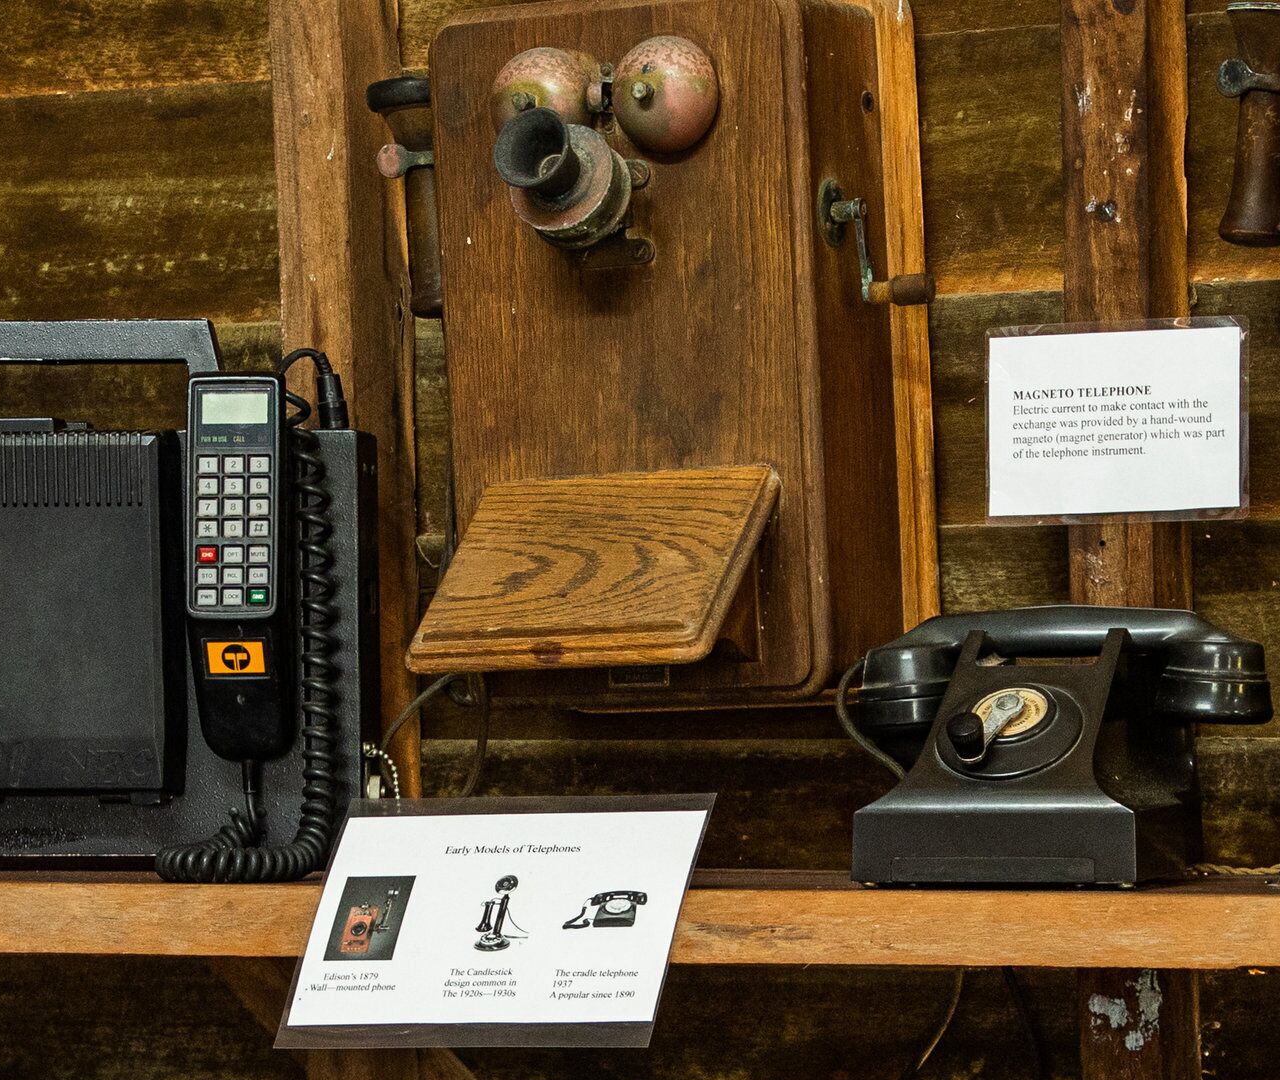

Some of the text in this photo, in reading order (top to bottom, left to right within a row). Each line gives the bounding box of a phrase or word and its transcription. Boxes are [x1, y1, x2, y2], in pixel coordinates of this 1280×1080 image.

[1013, 385, 1151, 401] MAGNETO TELEPHONE
[1013, 398, 1208, 416] Electric current to make contact with the
[1012, 413, 1212, 432] exchange was provided by a hand-wound
[1012, 427, 1224, 448] magneto (magnet generator) which was part
[1012, 444, 1145, 461] of the telephone instrument.
[445, 844, 581, 856] Early Models of Telephones
[323, 971, 378, 980] Edison's 1879
[448, 967, 513, 977] The Candlestick
[554, 968, 638, 979] The cradle telephone
[310, 982, 396, 993] Wall—mounted phone
[444, 978, 470, 989] design
[508, 977, 517, 986] in
[552, 979, 572, 988] 1937
[440, 988, 516, 998] The 1920s—1930s
[550, 989, 635, 1001] A popular since 1890
